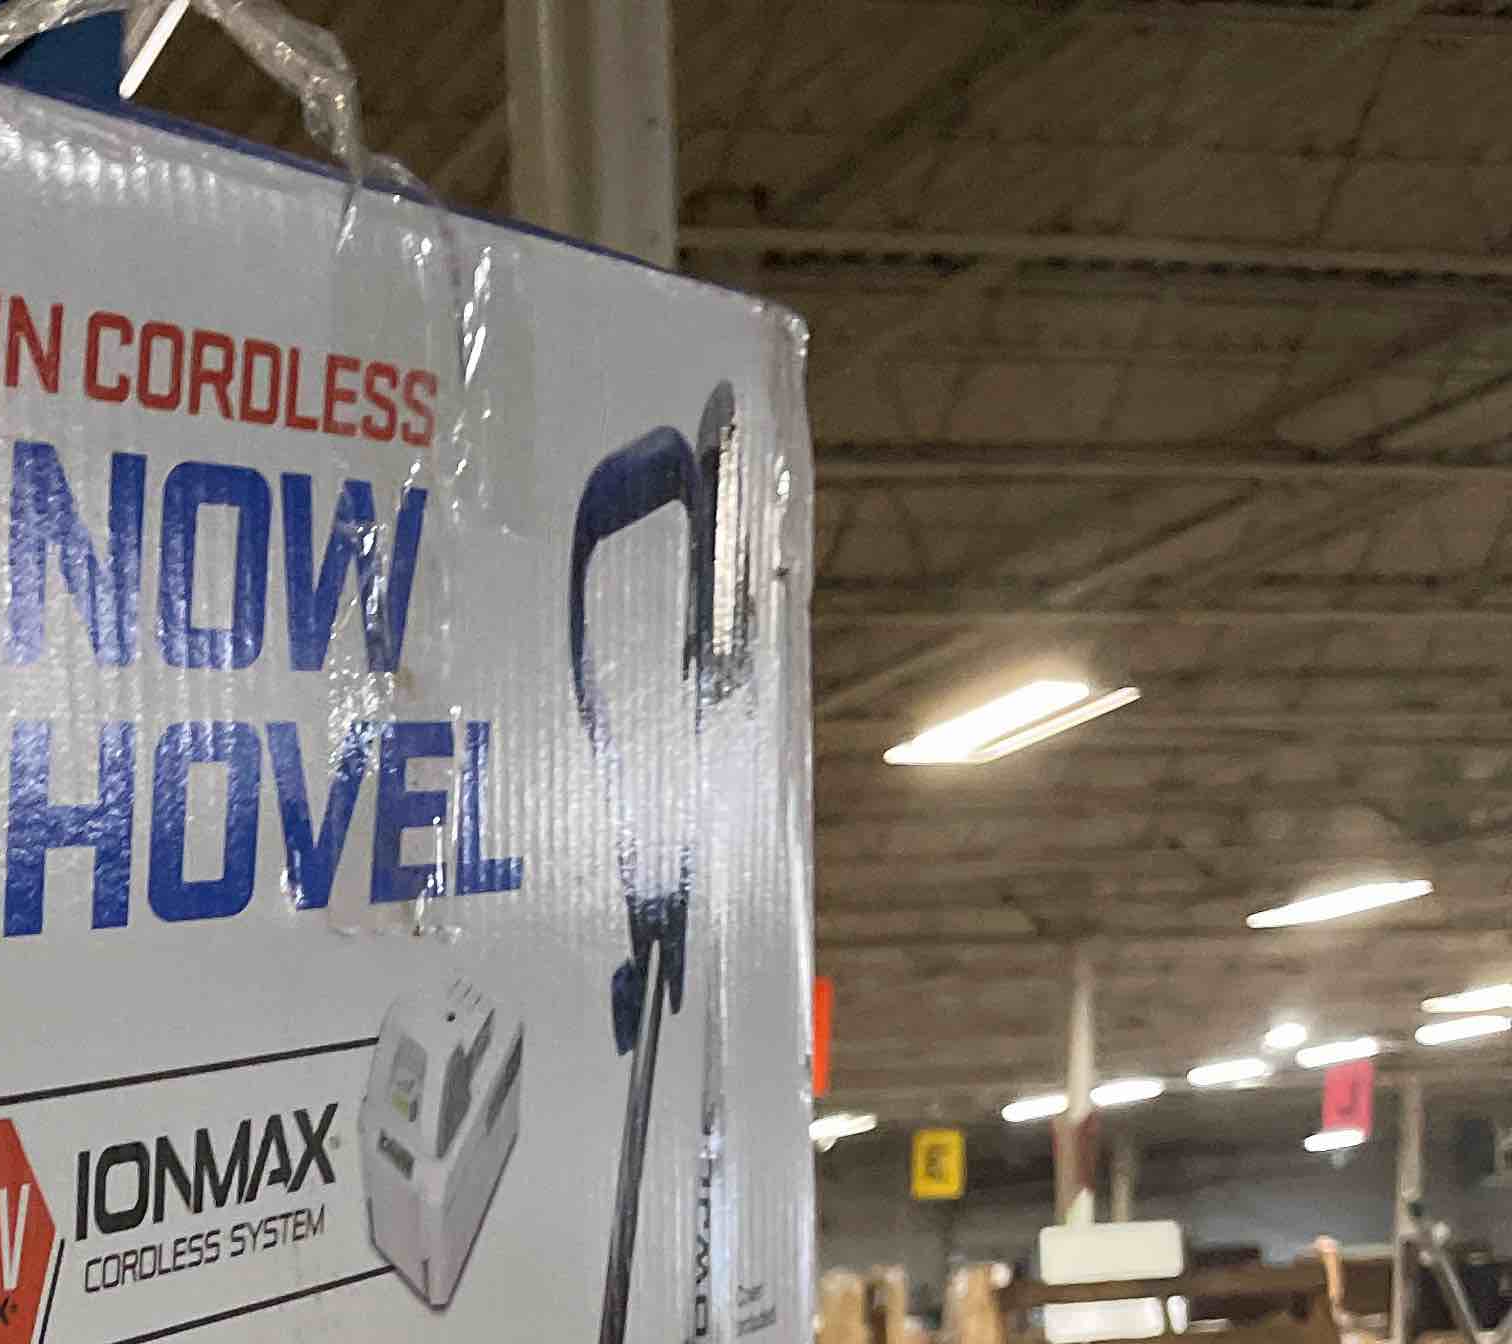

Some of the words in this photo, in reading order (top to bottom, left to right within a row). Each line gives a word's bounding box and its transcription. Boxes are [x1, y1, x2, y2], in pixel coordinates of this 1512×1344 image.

[85, 311, 439, 448] CORDLESS
[74, 1102, 340, 1241] IONMAX
[84, 1236, 221, 1294] CORDLESS
[230, 1203, 326, 1261] SYSTEM
